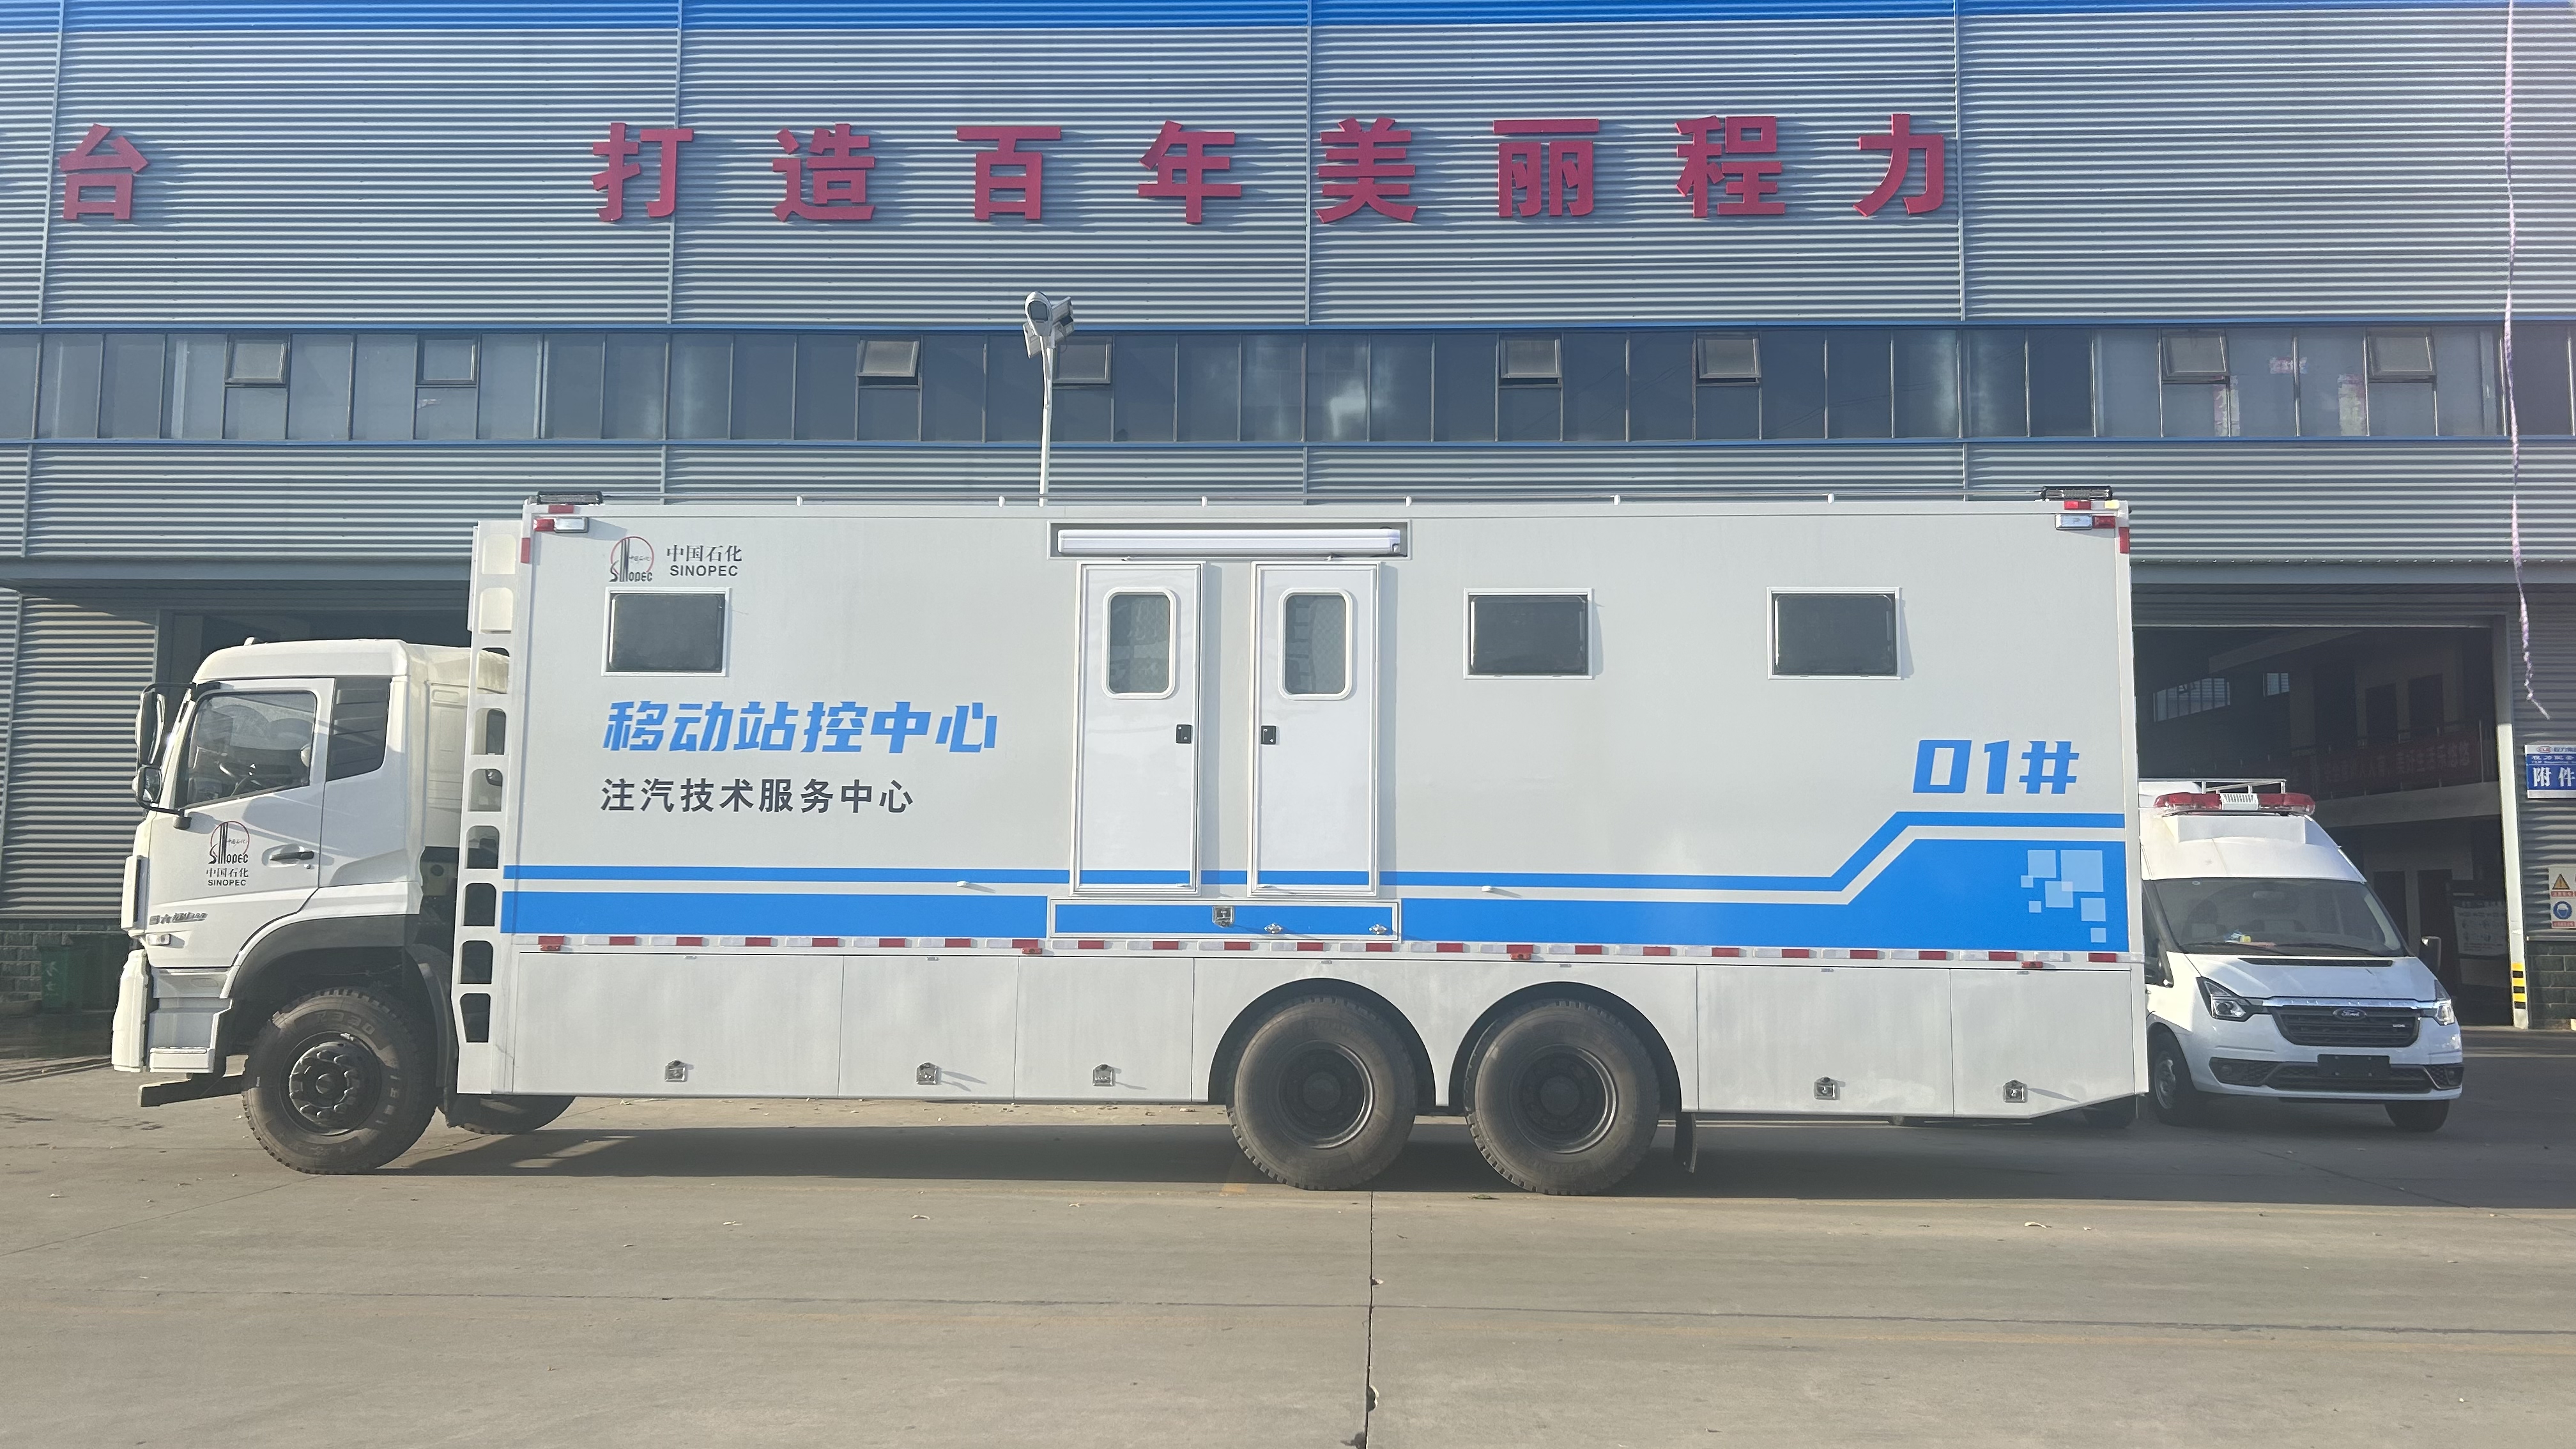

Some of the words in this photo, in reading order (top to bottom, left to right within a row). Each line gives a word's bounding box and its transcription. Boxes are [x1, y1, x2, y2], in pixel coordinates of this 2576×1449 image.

[59, 125, 149, 221] 台
[592, 114, 1945, 224] 打造百年美丽程力
[666, 544, 742, 562] 中国石化
[670, 565, 738, 576] SINOPEC
[602, 700, 998, 753] 移动站控中心
[1912, 739, 2080, 795] 01#
[2533, 767, 2576, 787] 附件
[600, 777, 914, 814] 注汽技术服务中心
[206, 868, 249, 878] 中国石化
